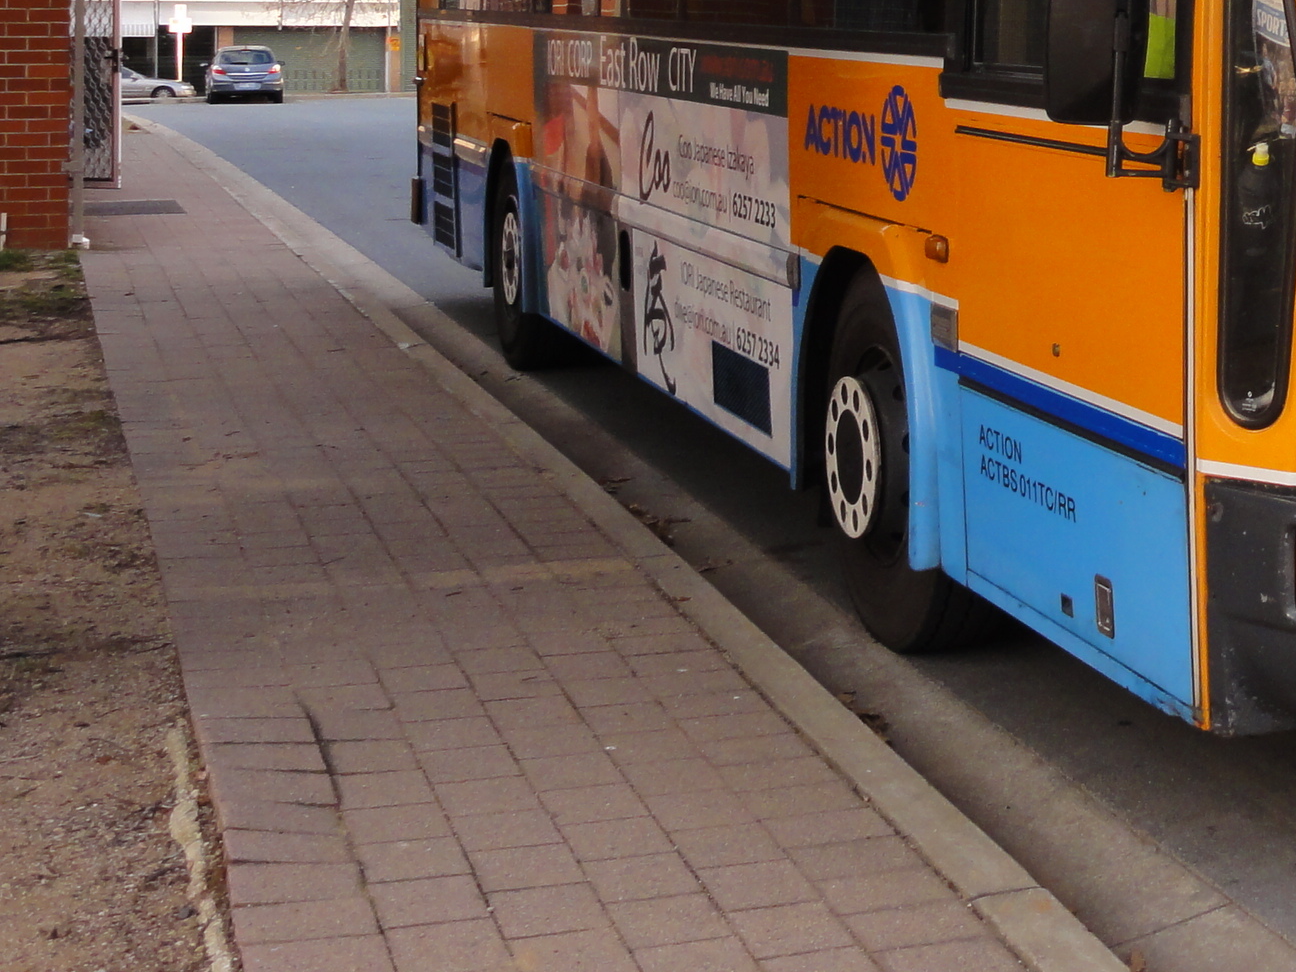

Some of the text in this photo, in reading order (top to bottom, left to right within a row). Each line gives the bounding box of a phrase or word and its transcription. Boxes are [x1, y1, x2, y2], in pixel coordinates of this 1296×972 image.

[547, 35, 698, 93] IORI CORP East Row CITY
[719, 83, 734, 102] Have
[734, 85, 742, 104] All
[741, 86, 753, 105] You
[753, 87, 770, 107] Need
[803, 102, 876, 166] ACTION
[693, 137, 726, 169] Japanese
[726, 144, 754, 180] Izakaya
[732, 192, 753, 220] 6257
[754, 198, 776, 229] 2233
[695, 268, 729, 303] Japanese
[729, 279, 772, 322] Restaurant
[736, 327, 756, 357] 6257
[758, 336, 780, 370] 2334
[979, 424, 1022, 465] ACTION
